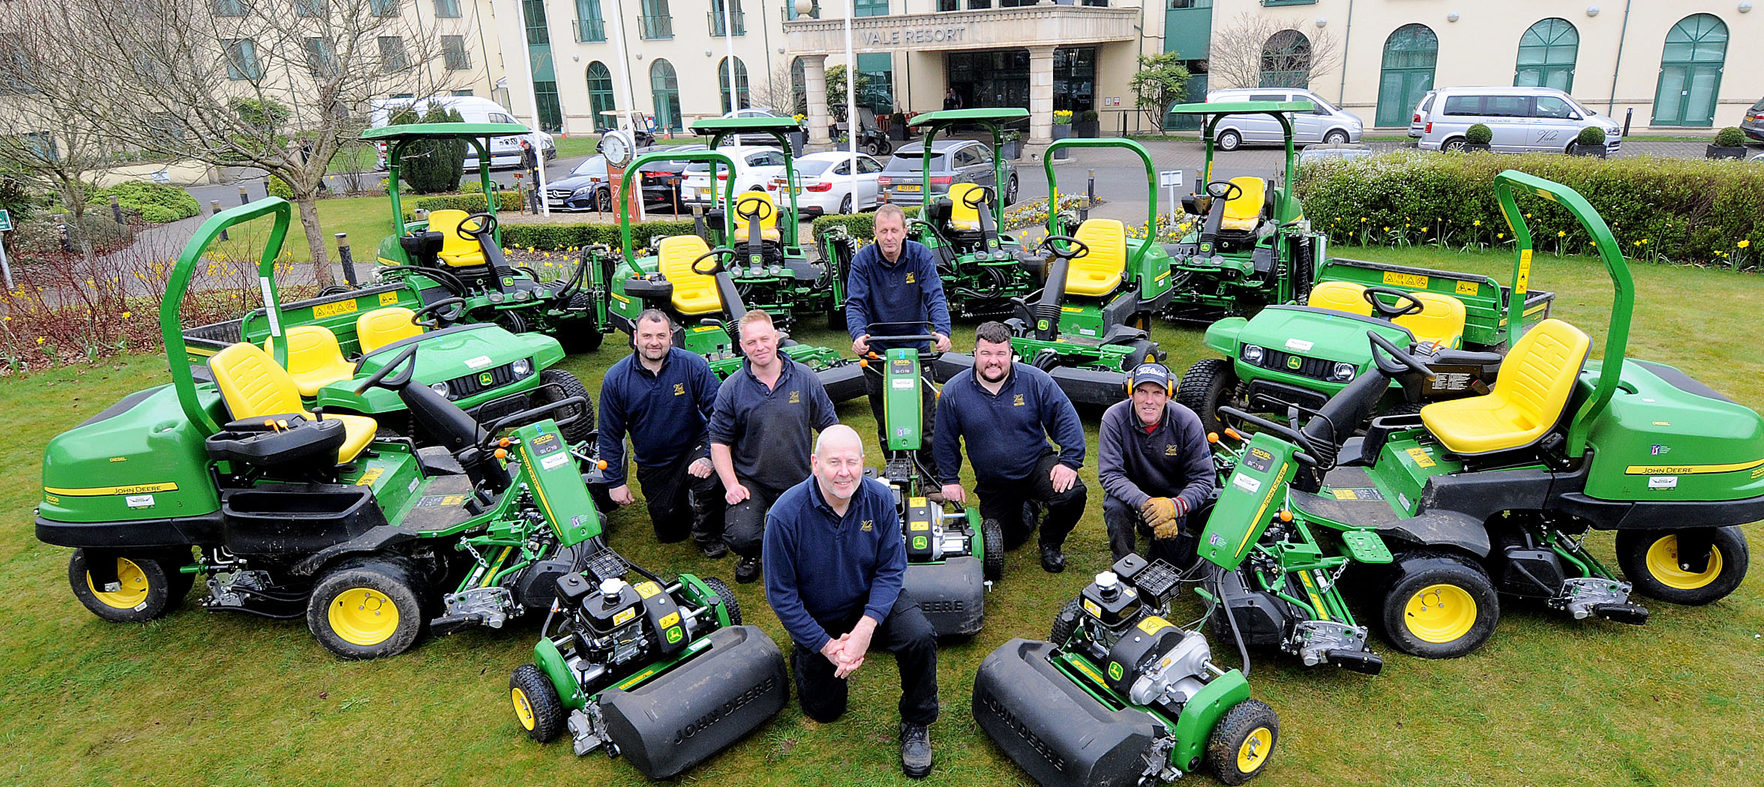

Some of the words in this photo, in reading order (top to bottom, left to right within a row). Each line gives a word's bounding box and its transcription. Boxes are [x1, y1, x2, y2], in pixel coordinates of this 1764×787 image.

[862, 31, 900, 45] VALE
[905, 27, 966, 43] RESORT
[1251, 447, 1271, 460] 220SL
[921, 600, 964, 613] EERE
[674, 708, 720, 745] JOHN
[723, 677, 774, 717] DEERE
[982, 691, 1015, 729] JOHN
[1018, 722, 1064, 772] DEERE
